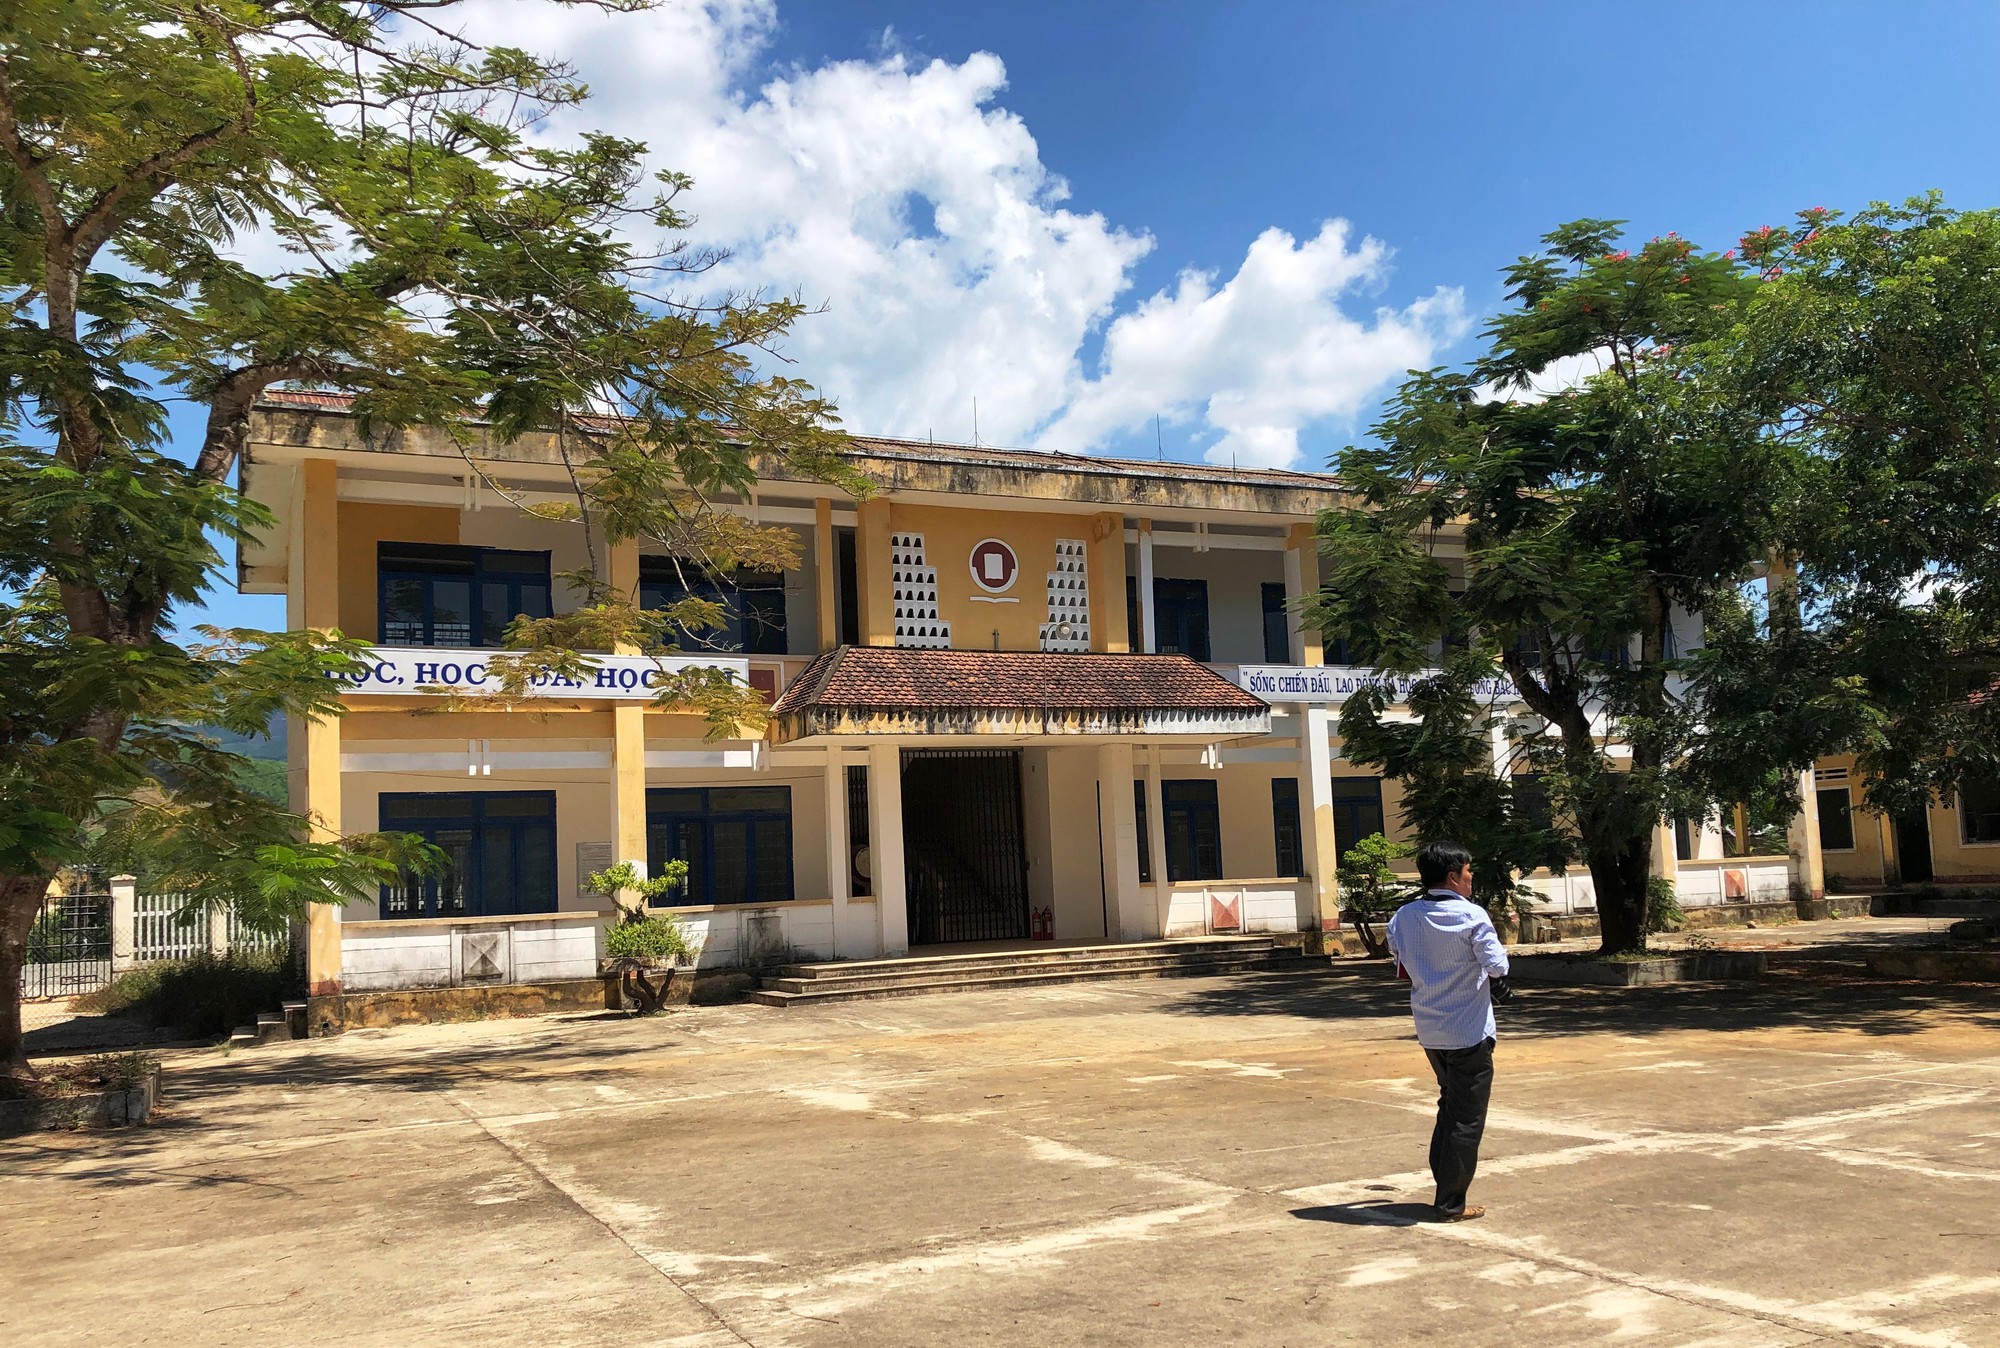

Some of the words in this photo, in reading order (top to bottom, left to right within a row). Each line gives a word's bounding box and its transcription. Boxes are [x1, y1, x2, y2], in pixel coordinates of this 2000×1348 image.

[1279, 671, 1308, 693] CHIẾN
[1311, 672, 1332, 695] ĐẤU,
[1336, 677, 1354, 693] LAO
